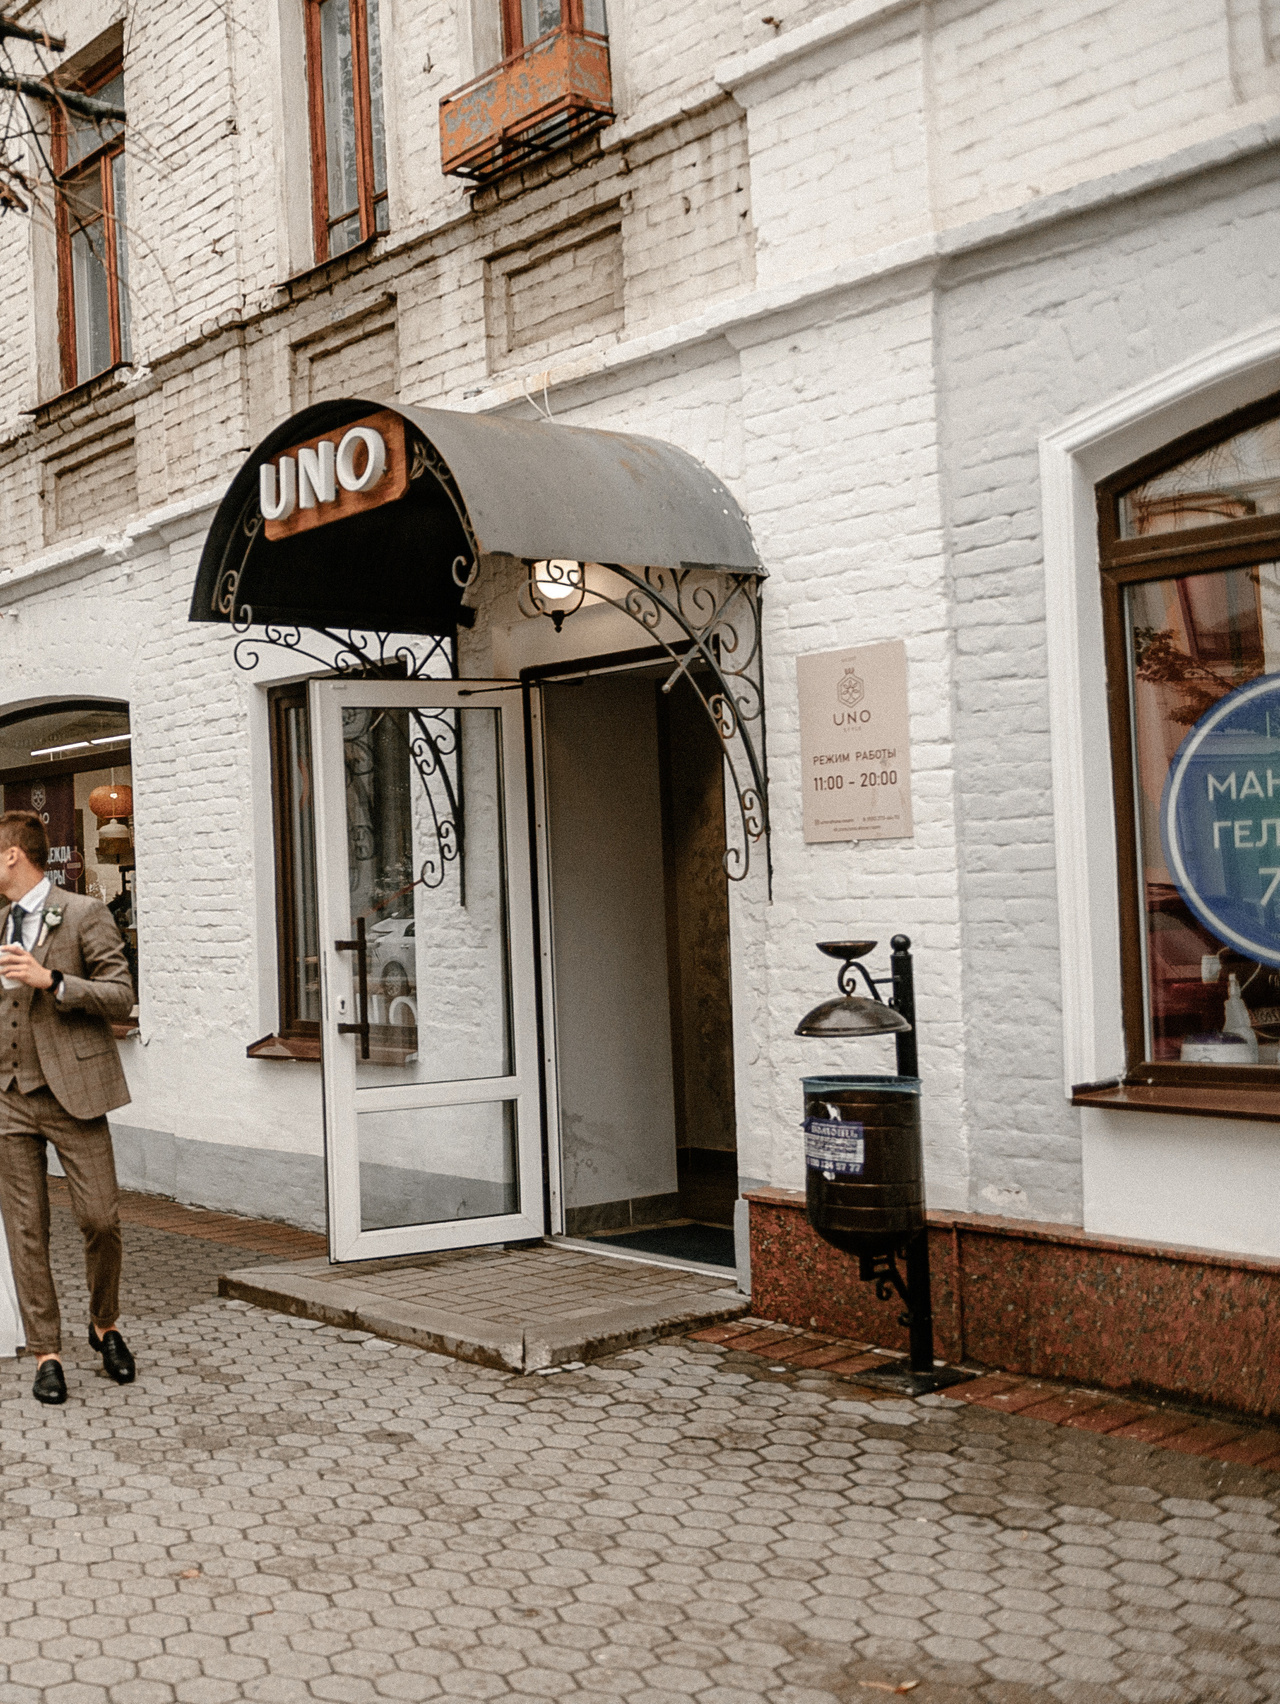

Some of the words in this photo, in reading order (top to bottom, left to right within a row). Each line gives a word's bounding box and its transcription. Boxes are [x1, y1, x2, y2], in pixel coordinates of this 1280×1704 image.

[260, 426, 386, 521] UNO
[833, 709, 871, 726] UNO
[813, 753, 850, 765] РЕЖИМ
[855, 748, 896, 761] РАБОТЫ
[814, 775, 843, 791] 11:00
[860, 770, 897, 787] 20:00
